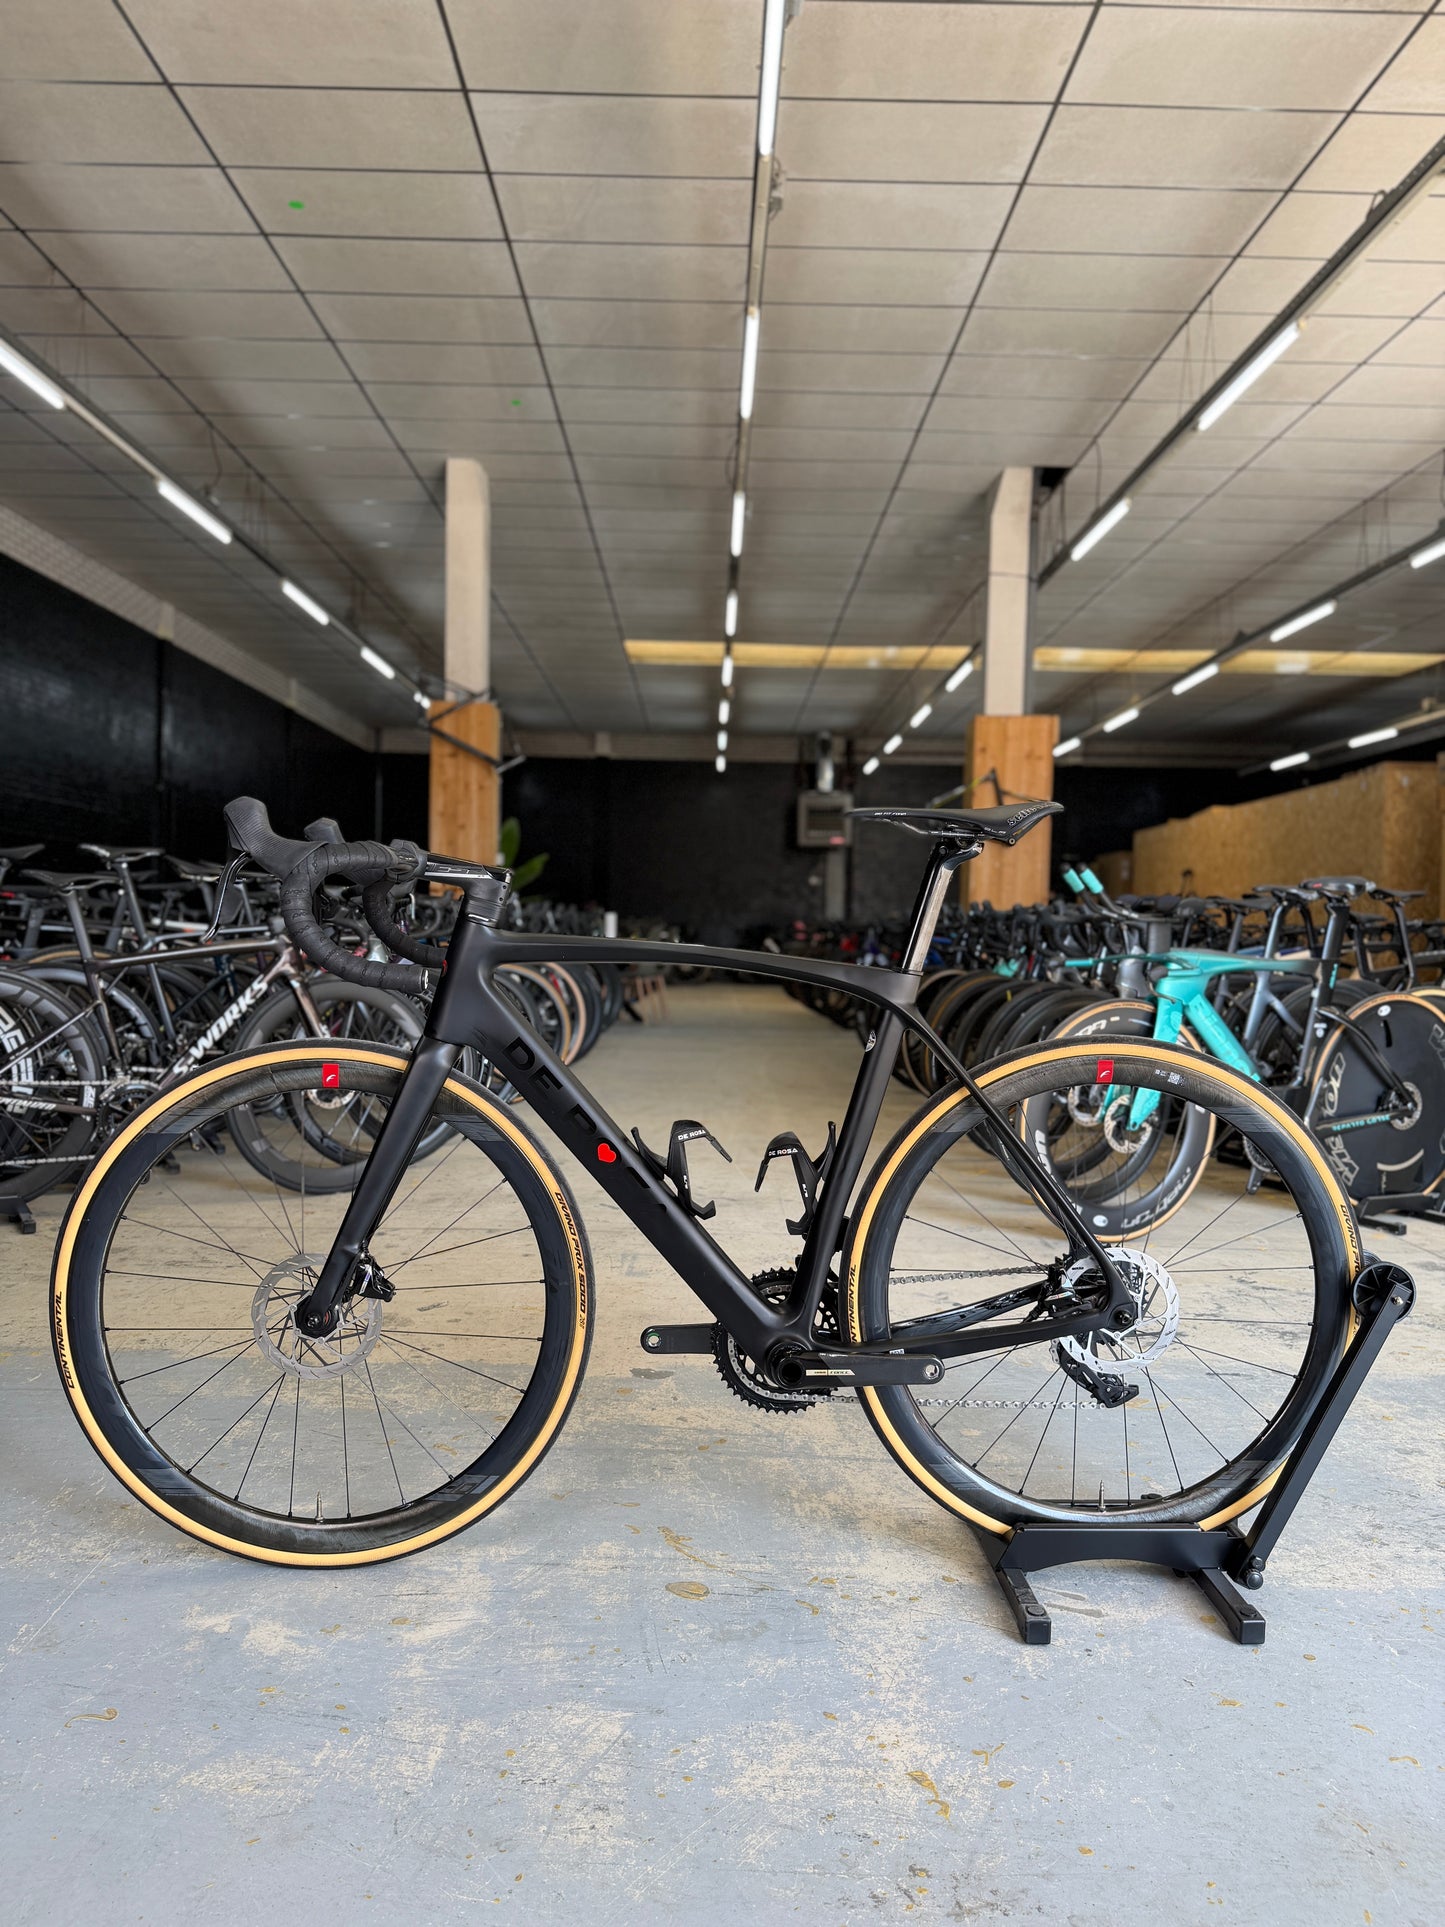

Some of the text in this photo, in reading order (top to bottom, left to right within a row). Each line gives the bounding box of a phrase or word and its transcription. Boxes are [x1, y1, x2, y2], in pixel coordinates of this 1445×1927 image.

[172, 973, 268, 1076] S-WORKS
[502, 1036, 563, 1092] DE
[678, 1129, 706, 1141] DE ROSA
[777, 1147, 799, 1155] ROSA
[555, 1191, 577, 1237] GRAND
[1340, 1203, 1358, 1250] GRAND
[572, 1237, 585, 1272] PRIX
[578, 1272, 587, 1314] 5000
[848, 1264, 857, 1343] NTINENTAL
[55, 1291, 75, 1389] CONTINENTAL
